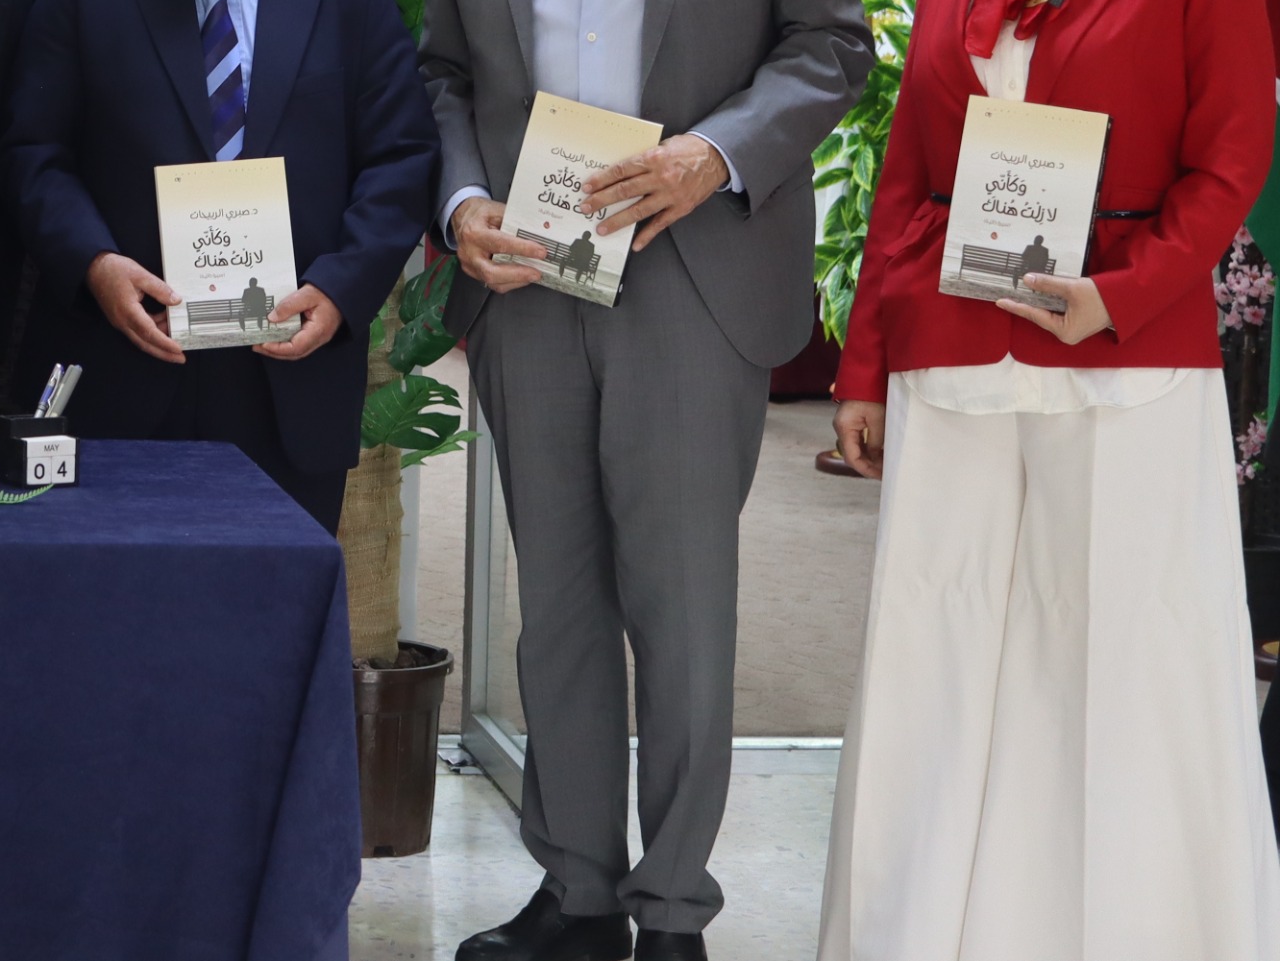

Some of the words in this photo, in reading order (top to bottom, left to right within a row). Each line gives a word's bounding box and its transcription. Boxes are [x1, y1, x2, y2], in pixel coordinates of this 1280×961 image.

[1046, 207, 1058, 222] لا
[254, 249, 263, 264] لا
[43, 444, 60, 452] MAY
